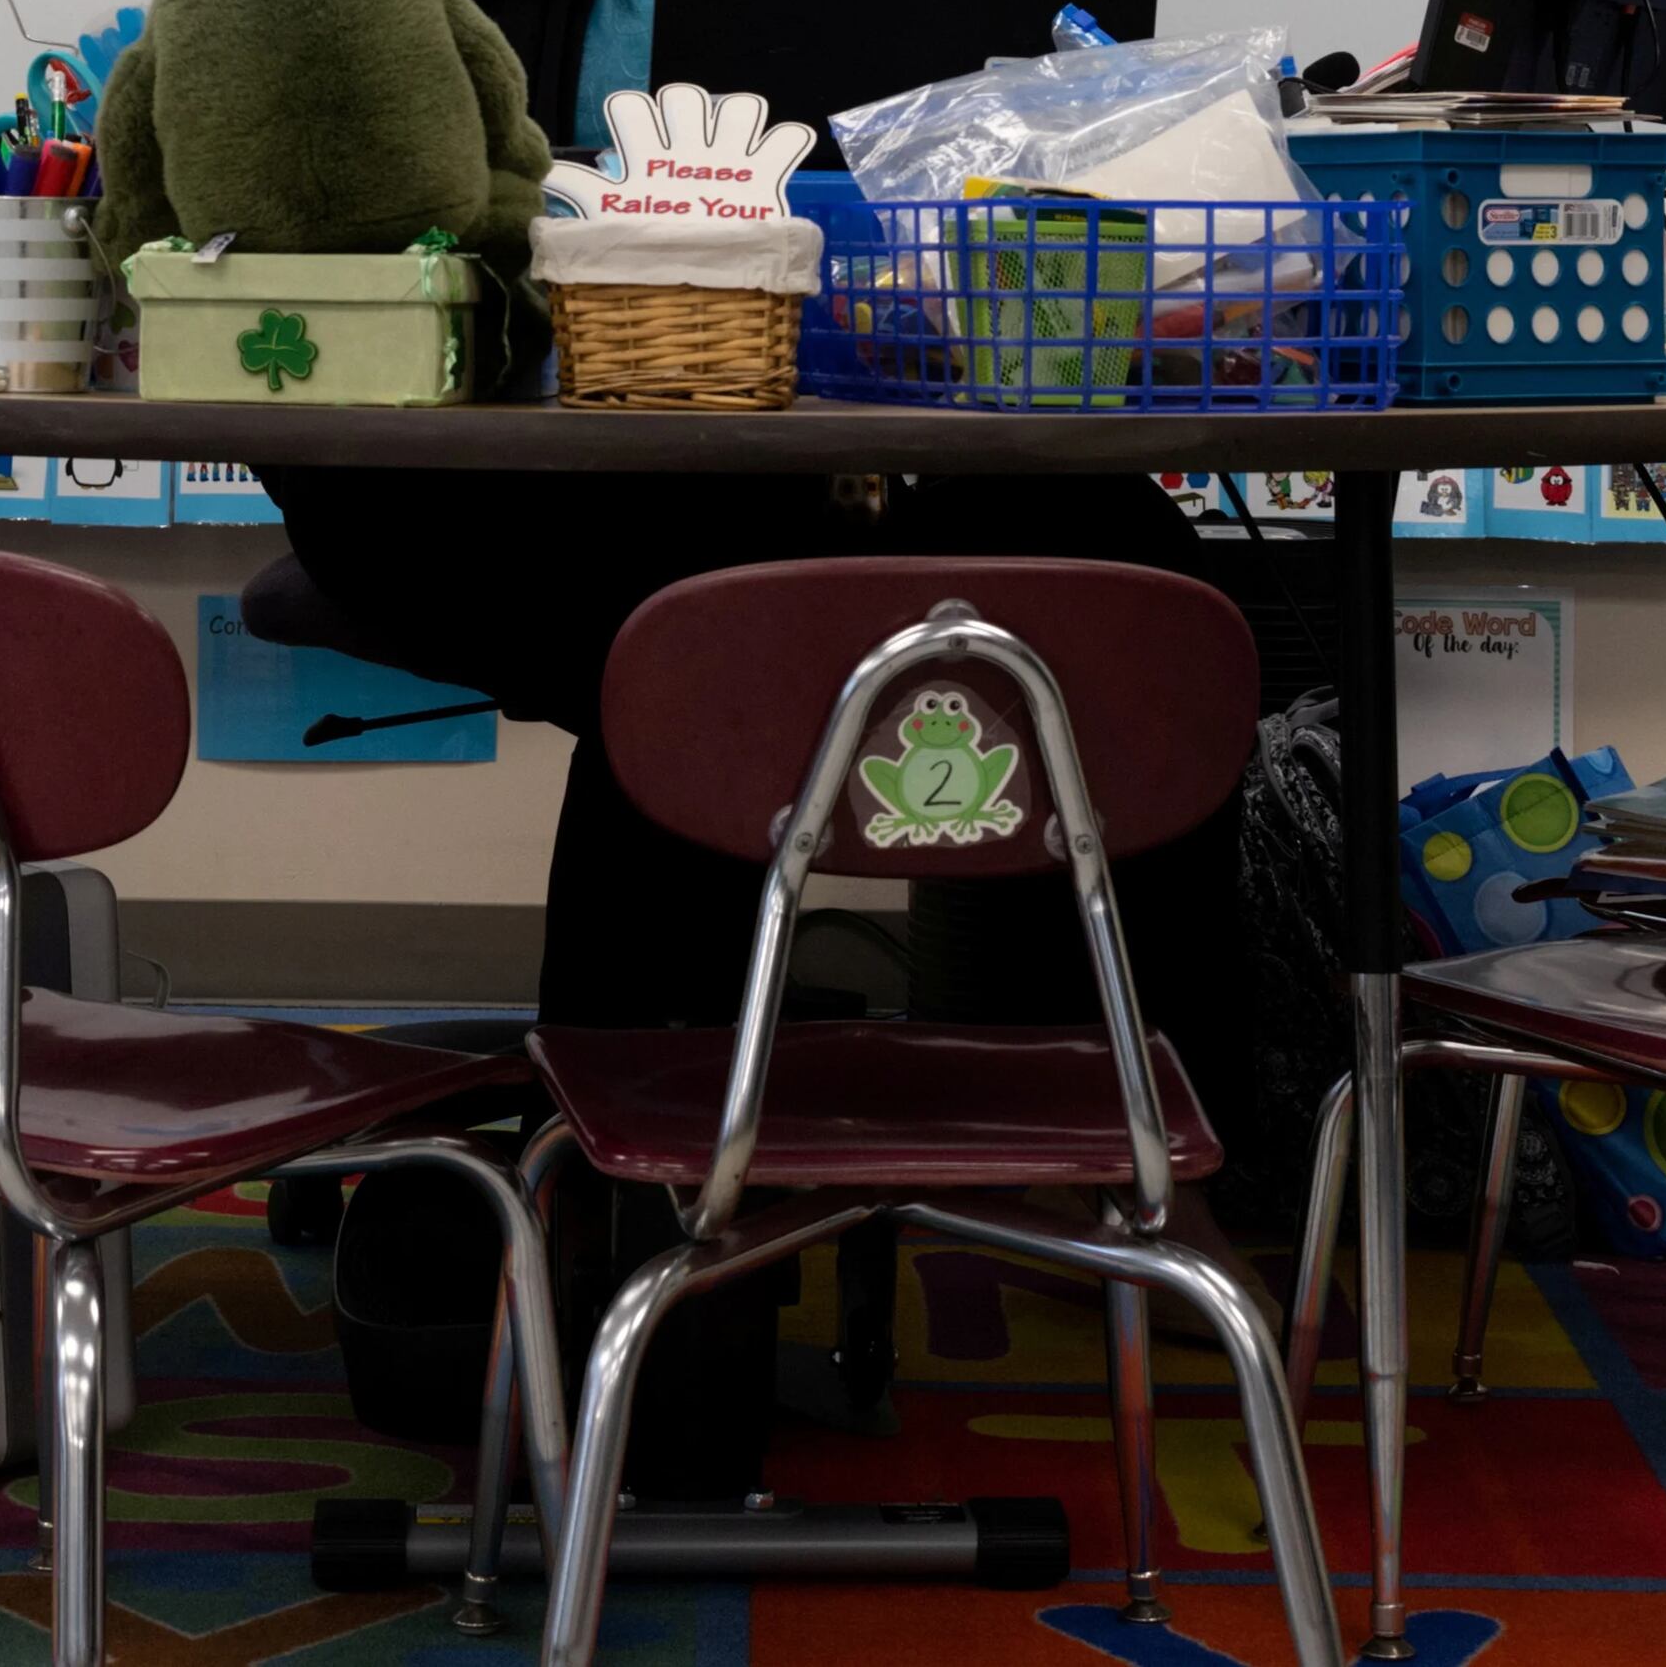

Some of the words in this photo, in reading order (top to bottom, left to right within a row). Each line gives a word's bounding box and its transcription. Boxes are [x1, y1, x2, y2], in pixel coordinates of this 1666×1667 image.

[646, 159, 753, 183] Please
[600, 193, 692, 217] Raise
[699, 197, 773, 221] Your
[1463, 611, 1537, 637] Word
[1413, 633, 1435, 658] Of
[1442, 634, 1473, 654] the
[1480, 635, 1519, 659] day:
[924, 760, 962, 806] 2
